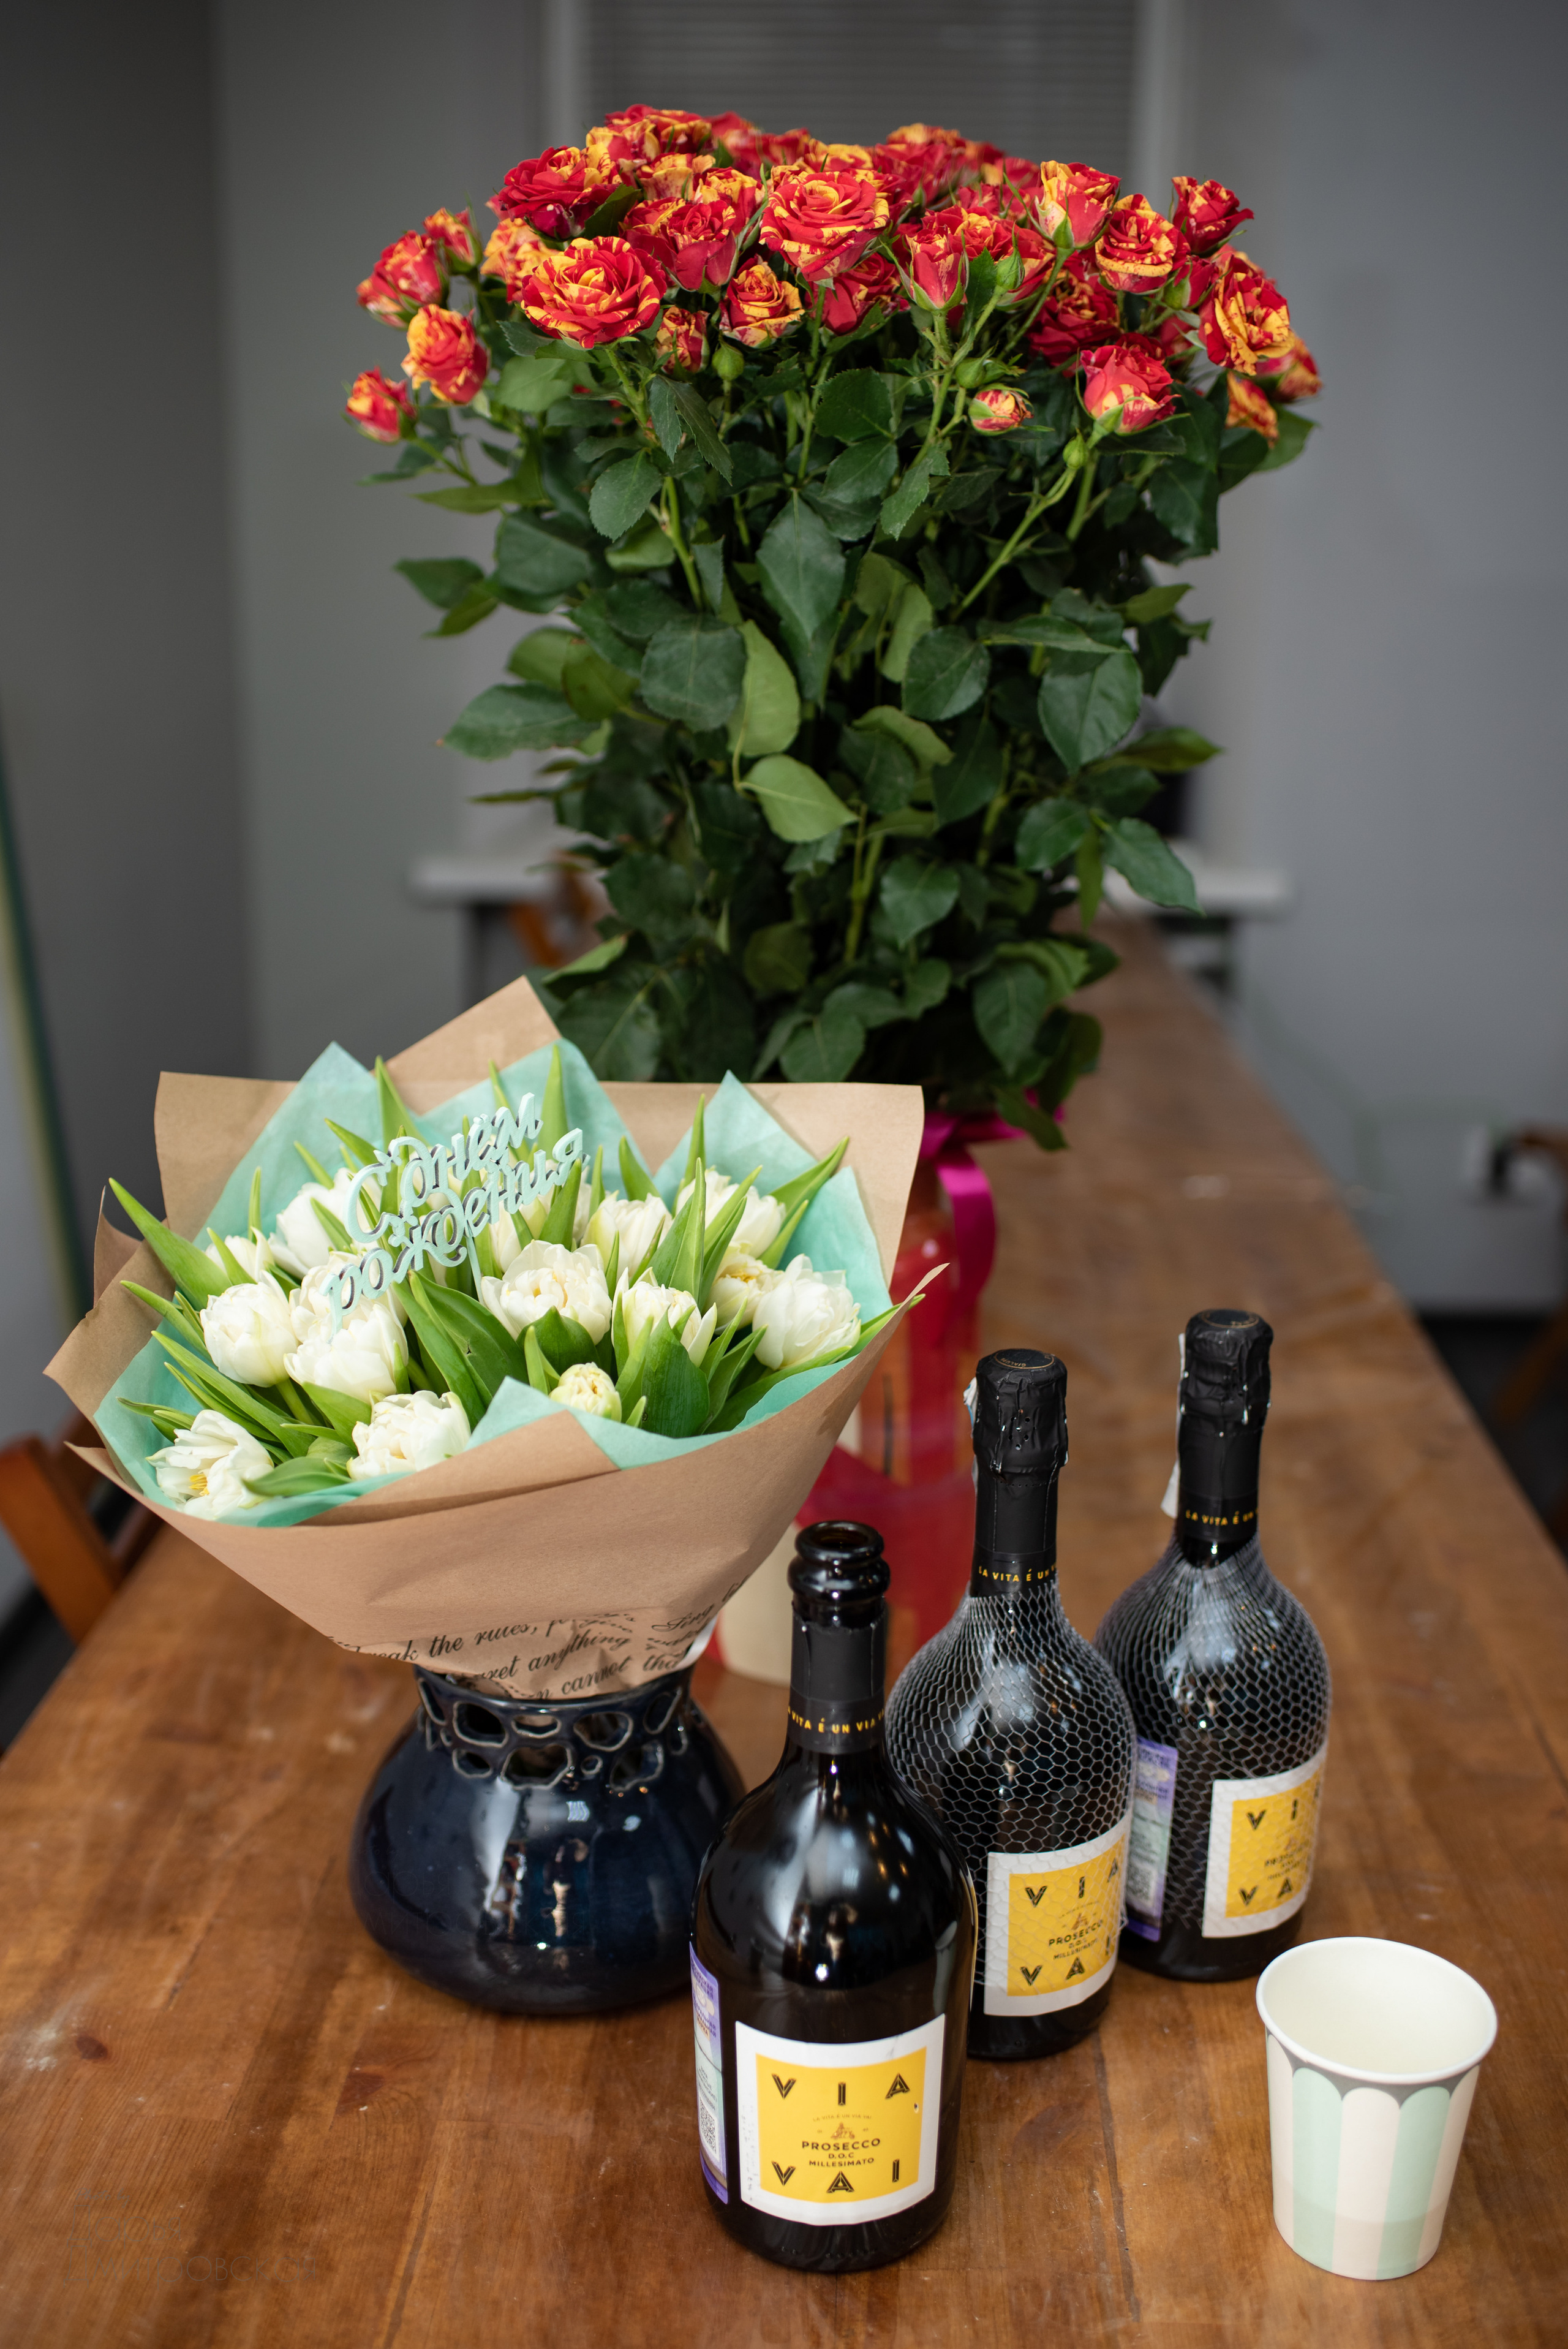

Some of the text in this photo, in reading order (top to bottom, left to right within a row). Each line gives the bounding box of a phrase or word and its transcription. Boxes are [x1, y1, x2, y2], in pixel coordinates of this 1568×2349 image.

[1202, 1515, 1228, 1526] VITA
[979, 1565, 989, 1578] LA
[992, 1572, 1020, 1583] VITA
[429, 1634, 464, 1658] the
[529, 1628, 631, 1671] anything
[561, 1655, 632, 1695] cannot
[792, 1710, 812, 1730] VITA
[832, 1723, 850, 1734] UN
[856, 1717, 876, 1732] VIA
[771, 2073, 910, 2106] VIA
[802, 2138, 881, 2151] PROSECCO
[809, 2157, 875, 2168] MILLESIMATO
[771, 2159, 900, 2193] VAI
